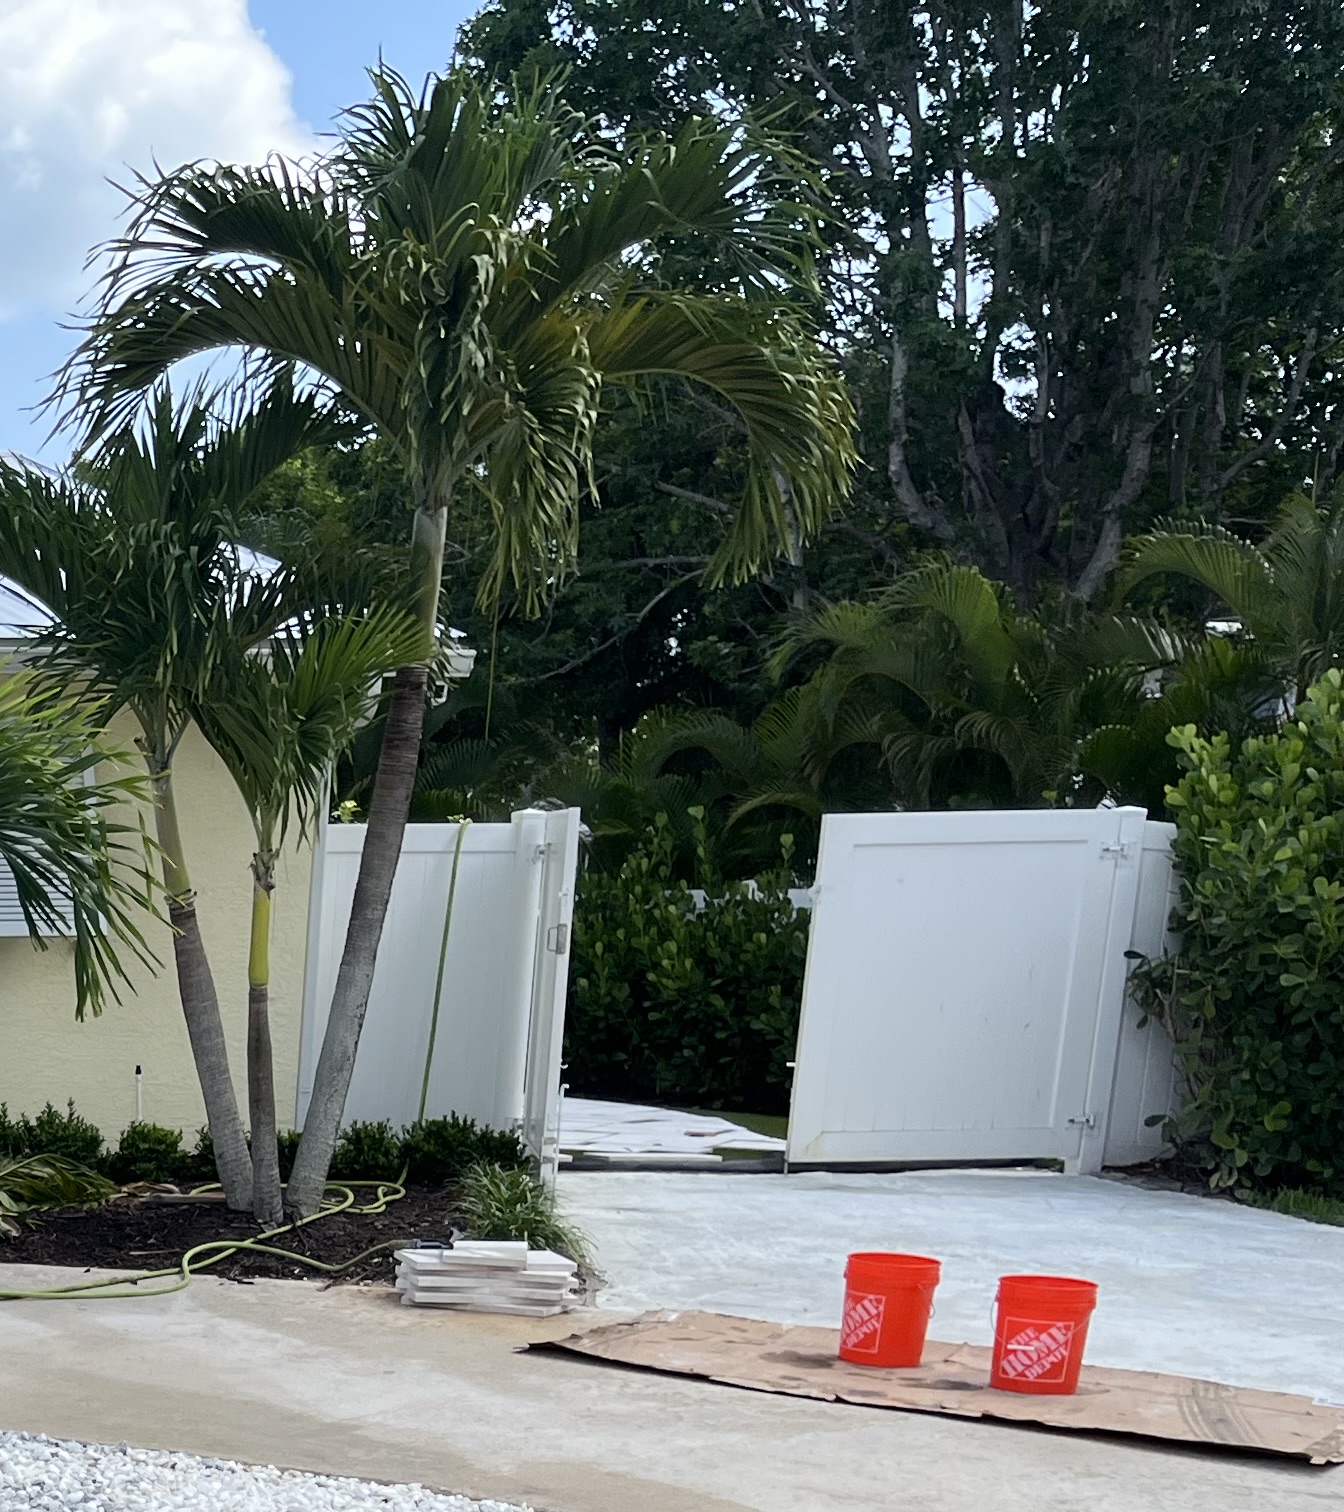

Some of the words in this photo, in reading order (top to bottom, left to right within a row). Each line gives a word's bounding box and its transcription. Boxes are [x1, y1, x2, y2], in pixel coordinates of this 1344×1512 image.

[842, 1295, 884, 1341] OME
[1001, 1322, 1072, 1377] HOME
[1024, 1344, 1069, 1379] DEPOT
